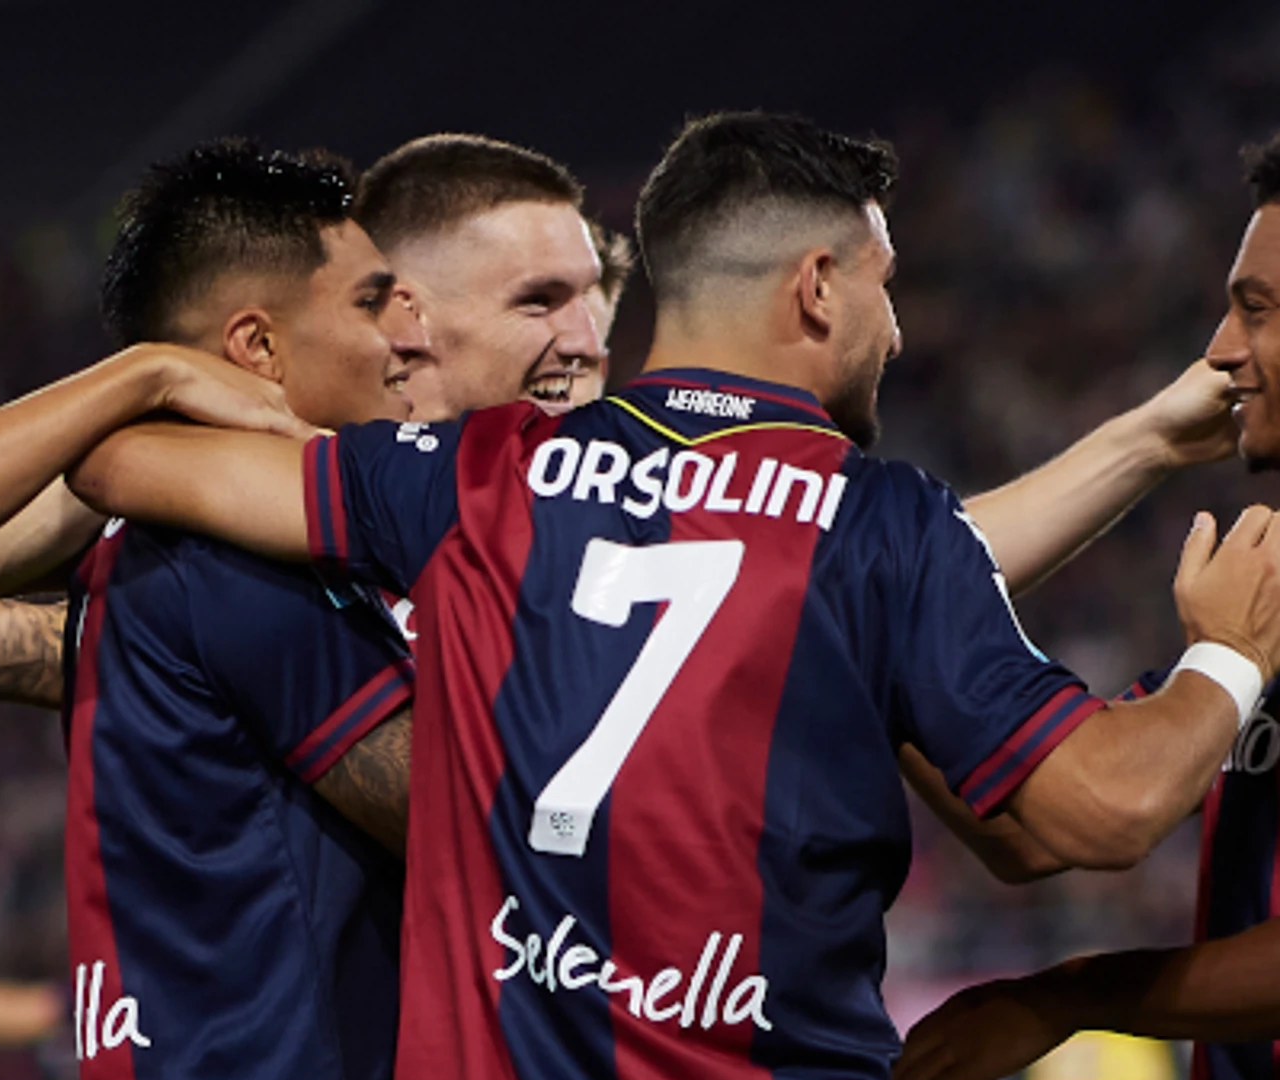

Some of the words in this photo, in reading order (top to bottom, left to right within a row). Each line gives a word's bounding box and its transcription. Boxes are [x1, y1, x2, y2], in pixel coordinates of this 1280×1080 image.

[527, 437, 848, 532] ORSOLINI
[528, 537, 746, 857] 7
[491, 895, 772, 1031] Selenella
